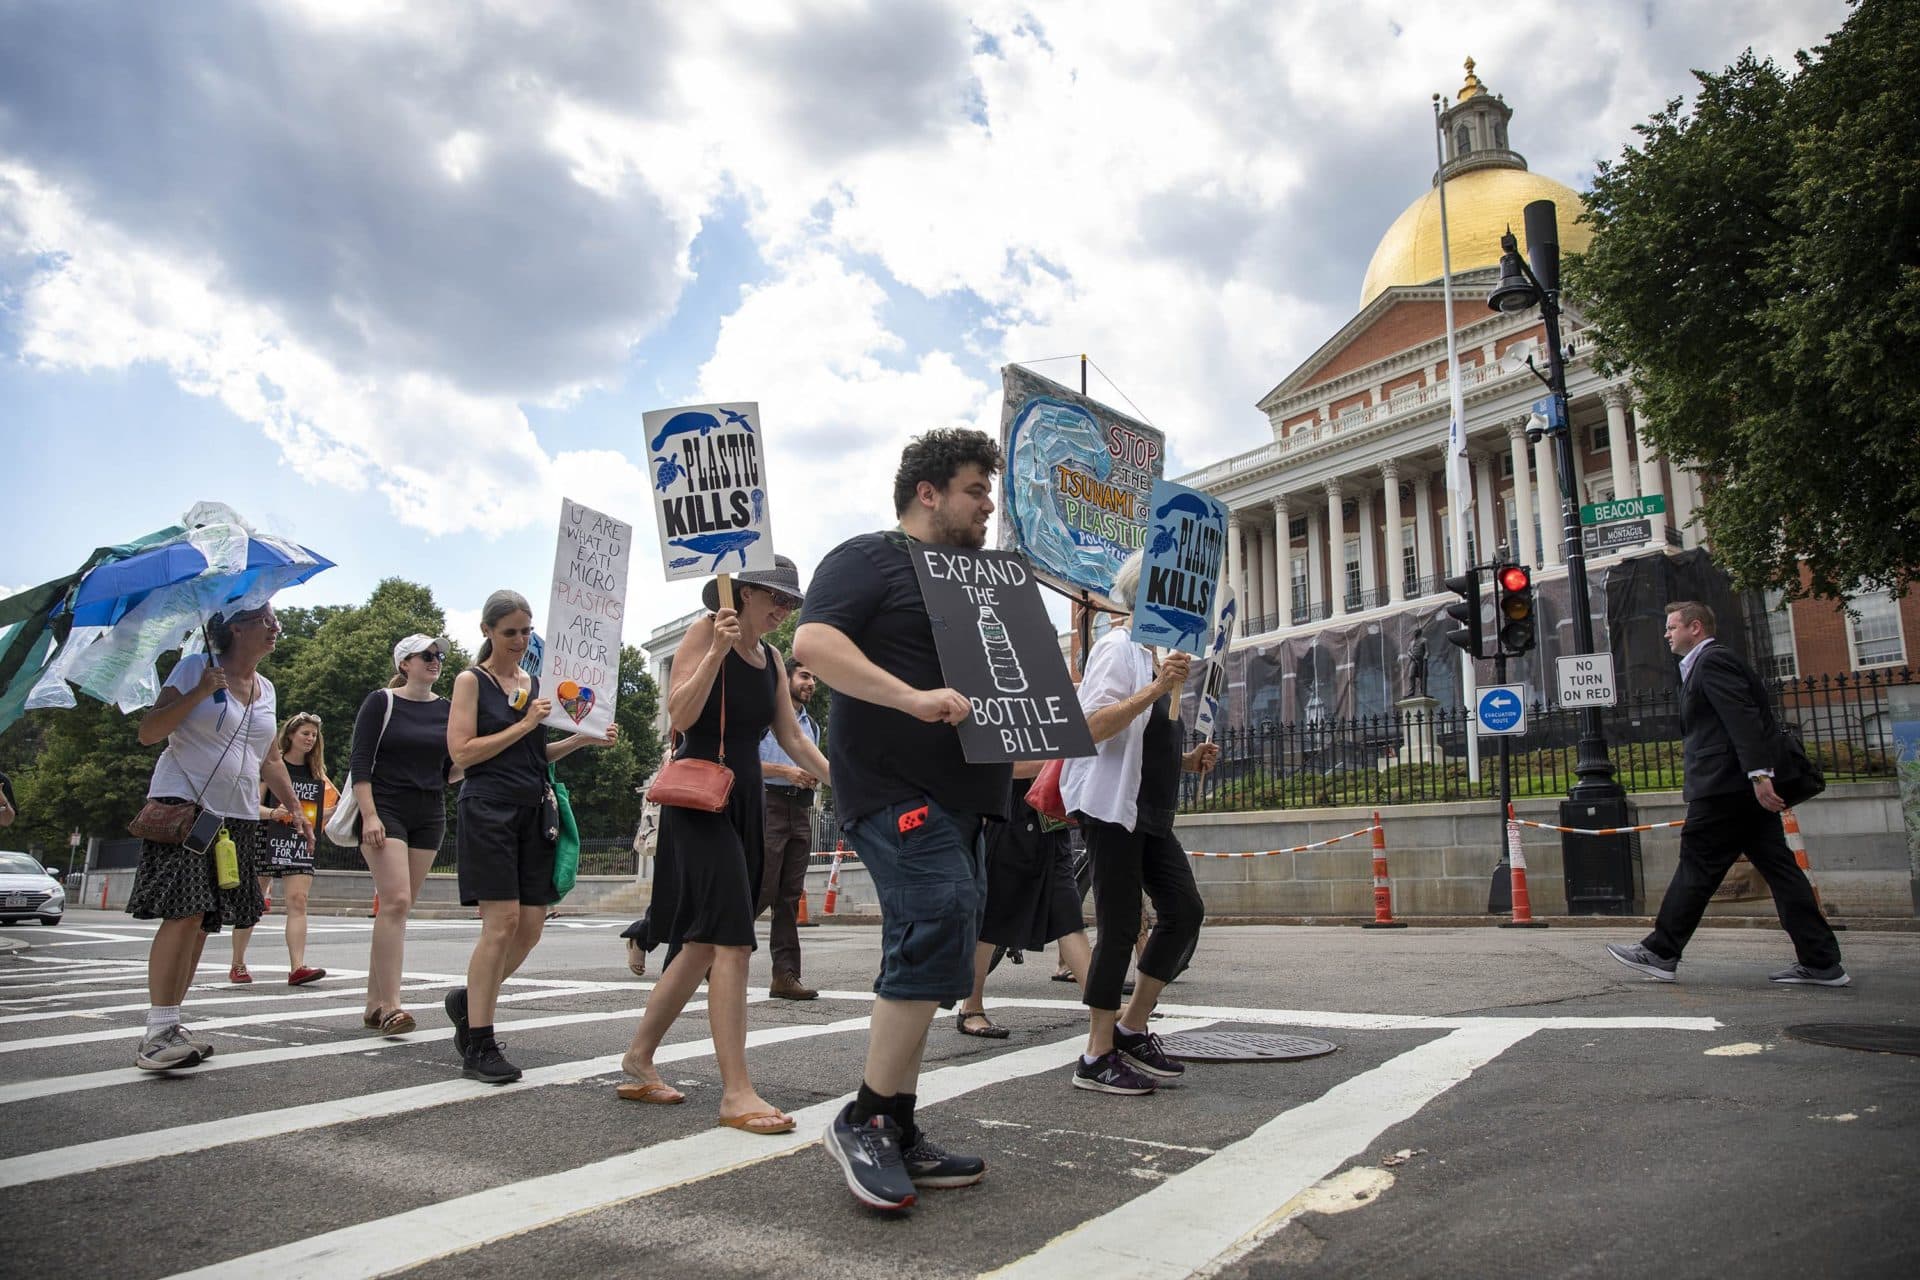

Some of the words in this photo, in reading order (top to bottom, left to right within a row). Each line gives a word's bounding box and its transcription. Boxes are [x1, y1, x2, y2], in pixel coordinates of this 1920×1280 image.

[1108, 425, 1158, 469] STOP
[682, 434, 759, 492] PLASTIC
[1057, 466, 1134, 520] TSUNAMI
[1122, 468, 1148, 490] THE
[570, 506, 584, 525] U
[592, 517, 623, 541] ARE
[663, 490, 750, 537] KILLS
[1595, 501, 1644, 520] BEACON
[1647, 504, 1656, 513] ST
[567, 526, 600, 551] WHAT
[609, 543, 620, 557] U
[1078, 531, 1130, 562] POLLUTIO
[1607, 526, 1644, 540] MONTAGUE
[577, 546, 611, 570] EAT!
[924, 551, 1026, 586] EXPAND
[569, 561, 615, 592] MICRO
[1146, 565, 1210, 616] KILLS
[557, 581, 622, 620] PLASTICS
[962, 585, 999, 605] THE
[569, 614, 603, 641] ARE
[555, 632, 572, 655] IN
[578, 640, 607, 665] OUR
[552, 655, 606, 688] BLOOD!
[1569, 674, 1603, 686] TURN
[1576, 661, 1593, 671] NO
[1564, 690, 1581, 701] ON
[1586, 688, 1611, 699] RED
[969, 696, 1068, 726] BOTTLE
[1484, 711, 1517, 719] EVACUATION
[1000, 728, 1059, 753] BILL
[270, 838, 296, 849] CLEAN
[275, 848, 293, 859] FOR
